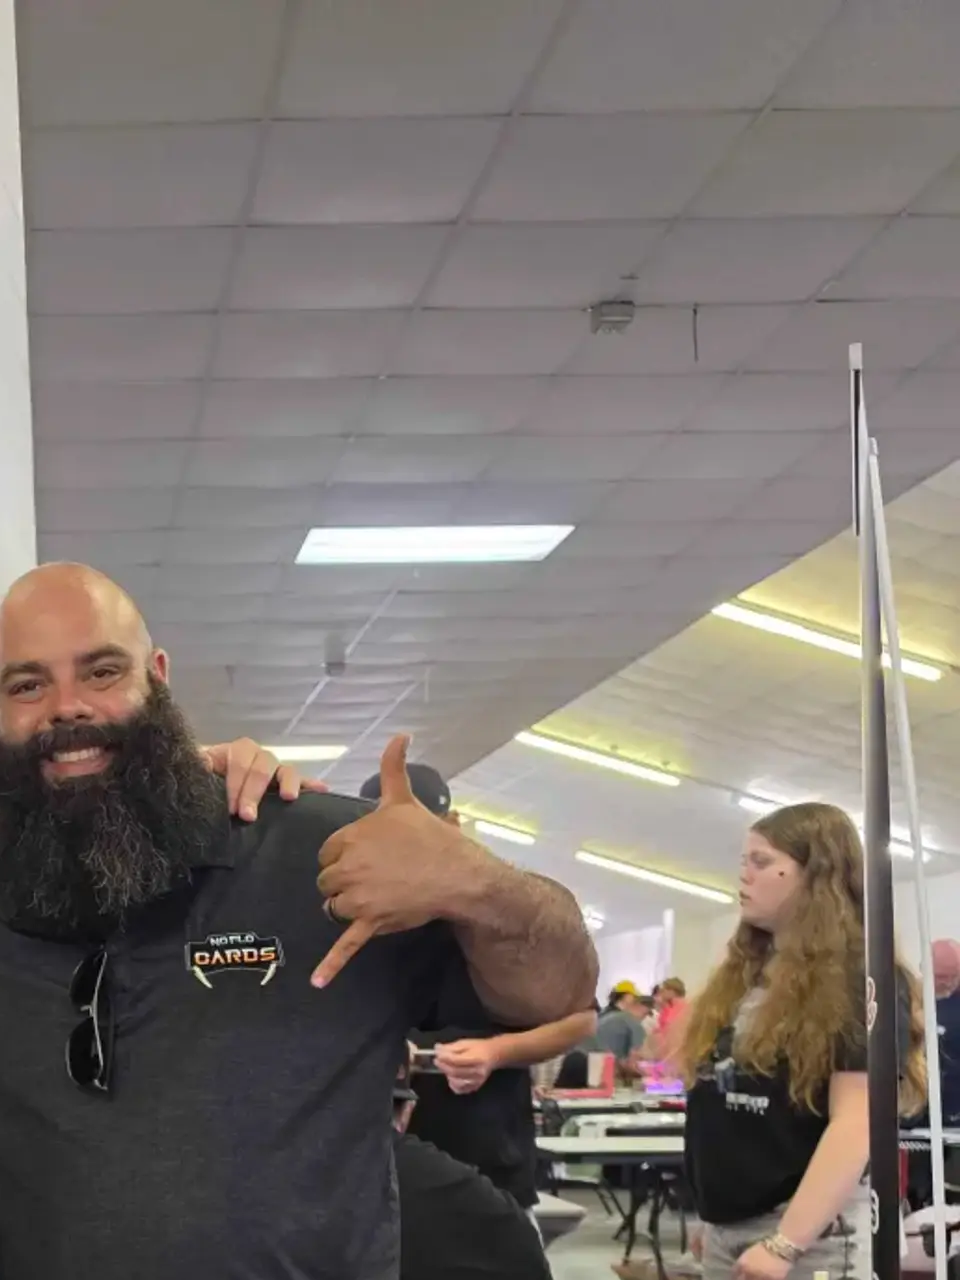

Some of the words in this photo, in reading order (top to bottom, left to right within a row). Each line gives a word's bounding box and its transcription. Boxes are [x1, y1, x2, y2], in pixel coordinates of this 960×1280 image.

[209, 936, 228, 947] NO
[228, 934, 256, 945] FLO
[193, 946, 277, 966] CARDS
